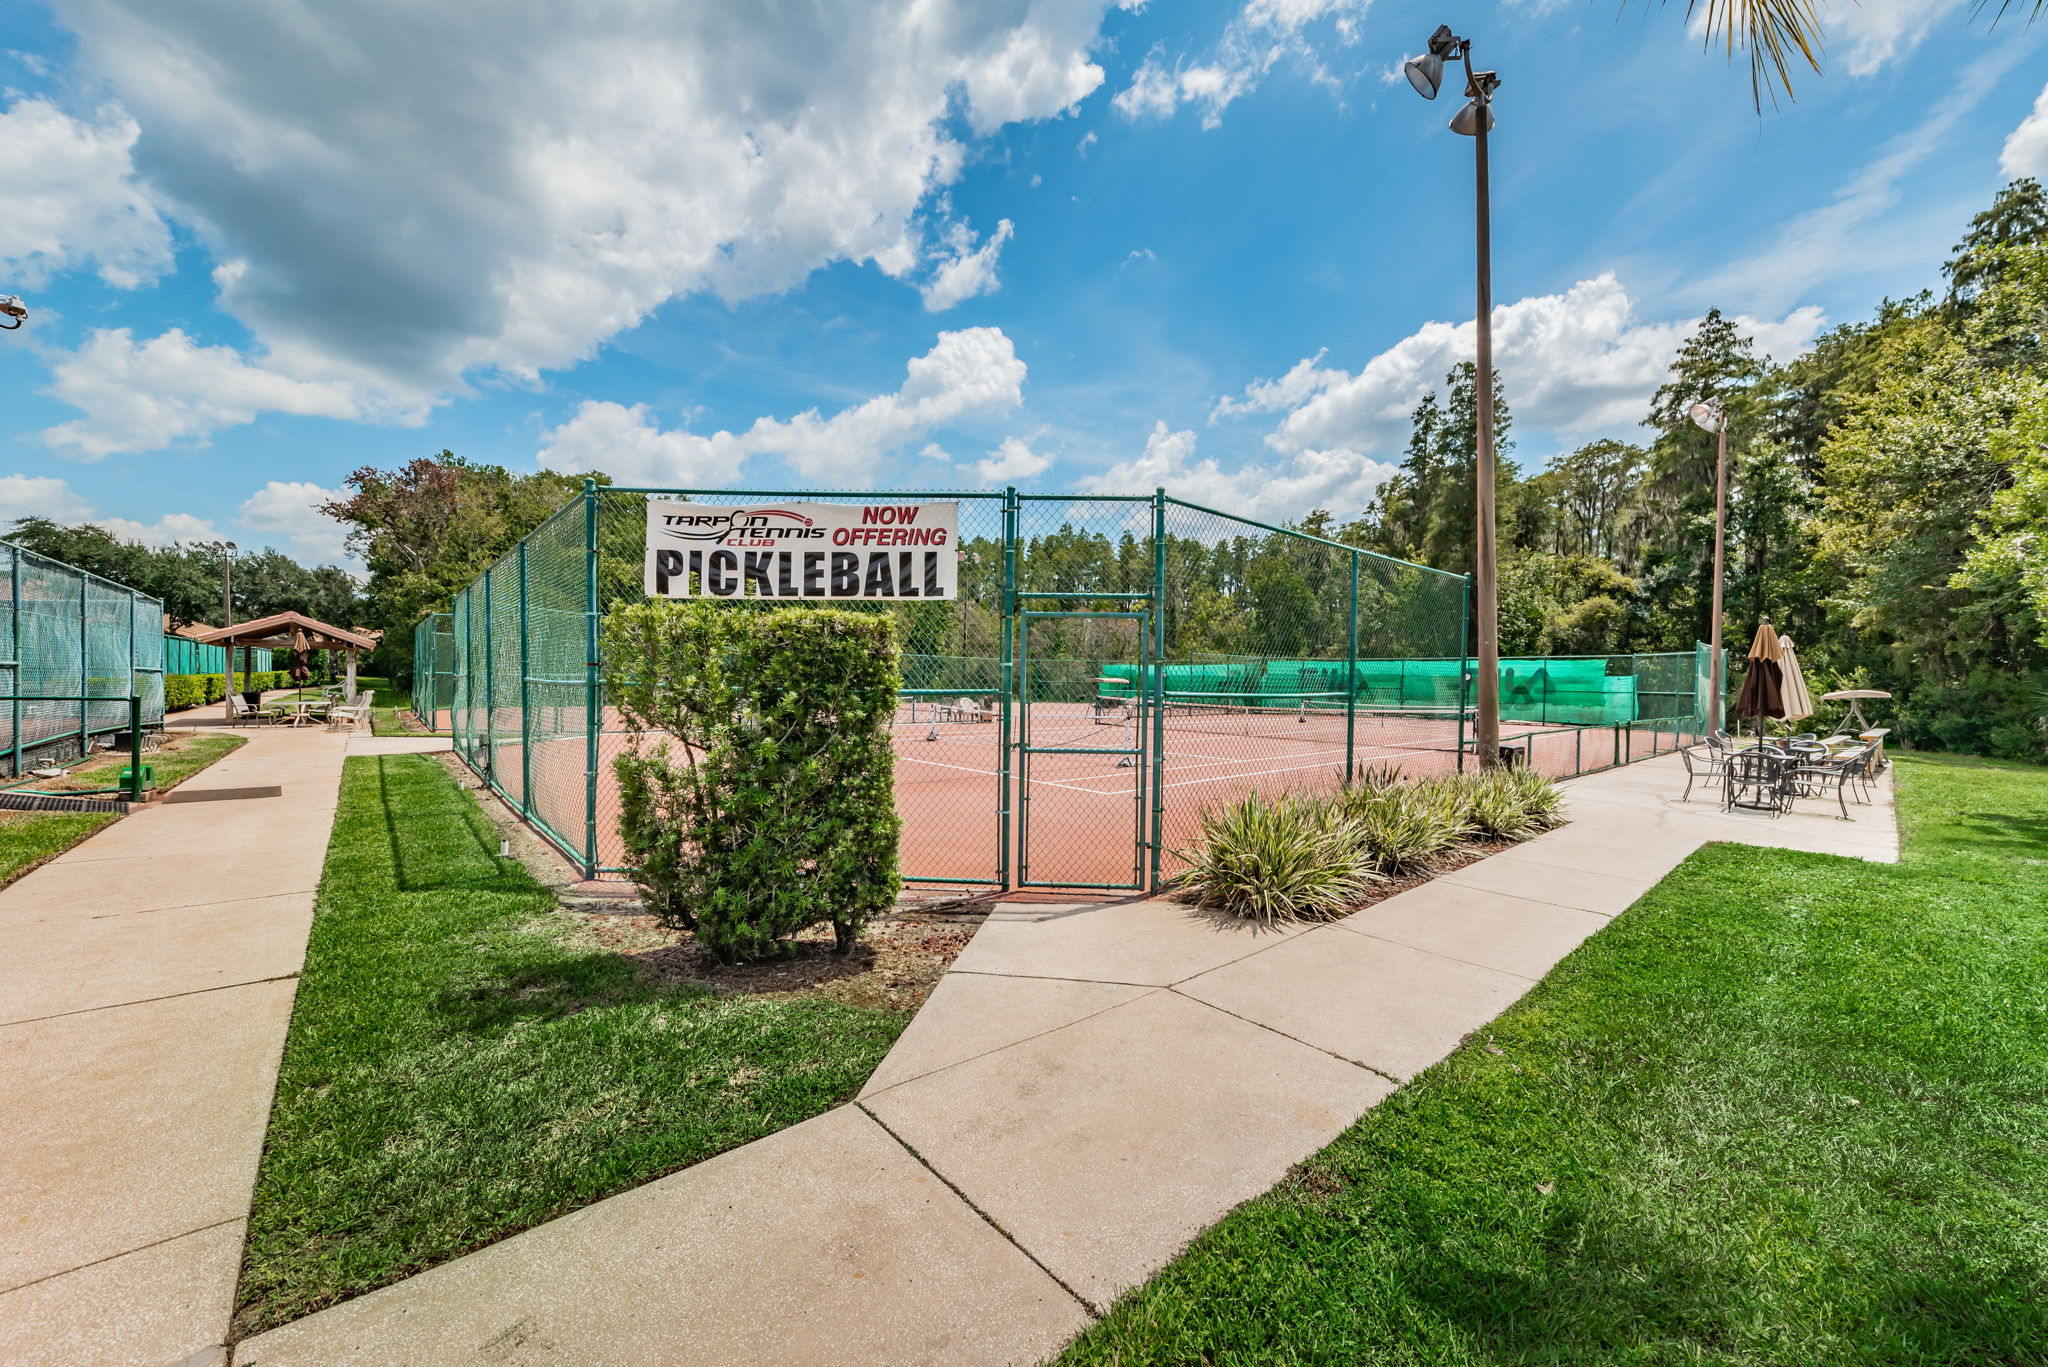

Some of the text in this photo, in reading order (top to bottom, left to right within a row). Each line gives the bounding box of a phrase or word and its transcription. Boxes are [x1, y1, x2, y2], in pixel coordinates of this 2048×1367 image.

[662, 510, 768, 529] TARPON
[862, 506, 919, 525] NOW
[726, 538, 775, 547] CLUB
[731, 527, 828, 539] TENNIS
[832, 527, 947, 546] OFFERING
[656, 549, 944, 597] PICKLEBALL
